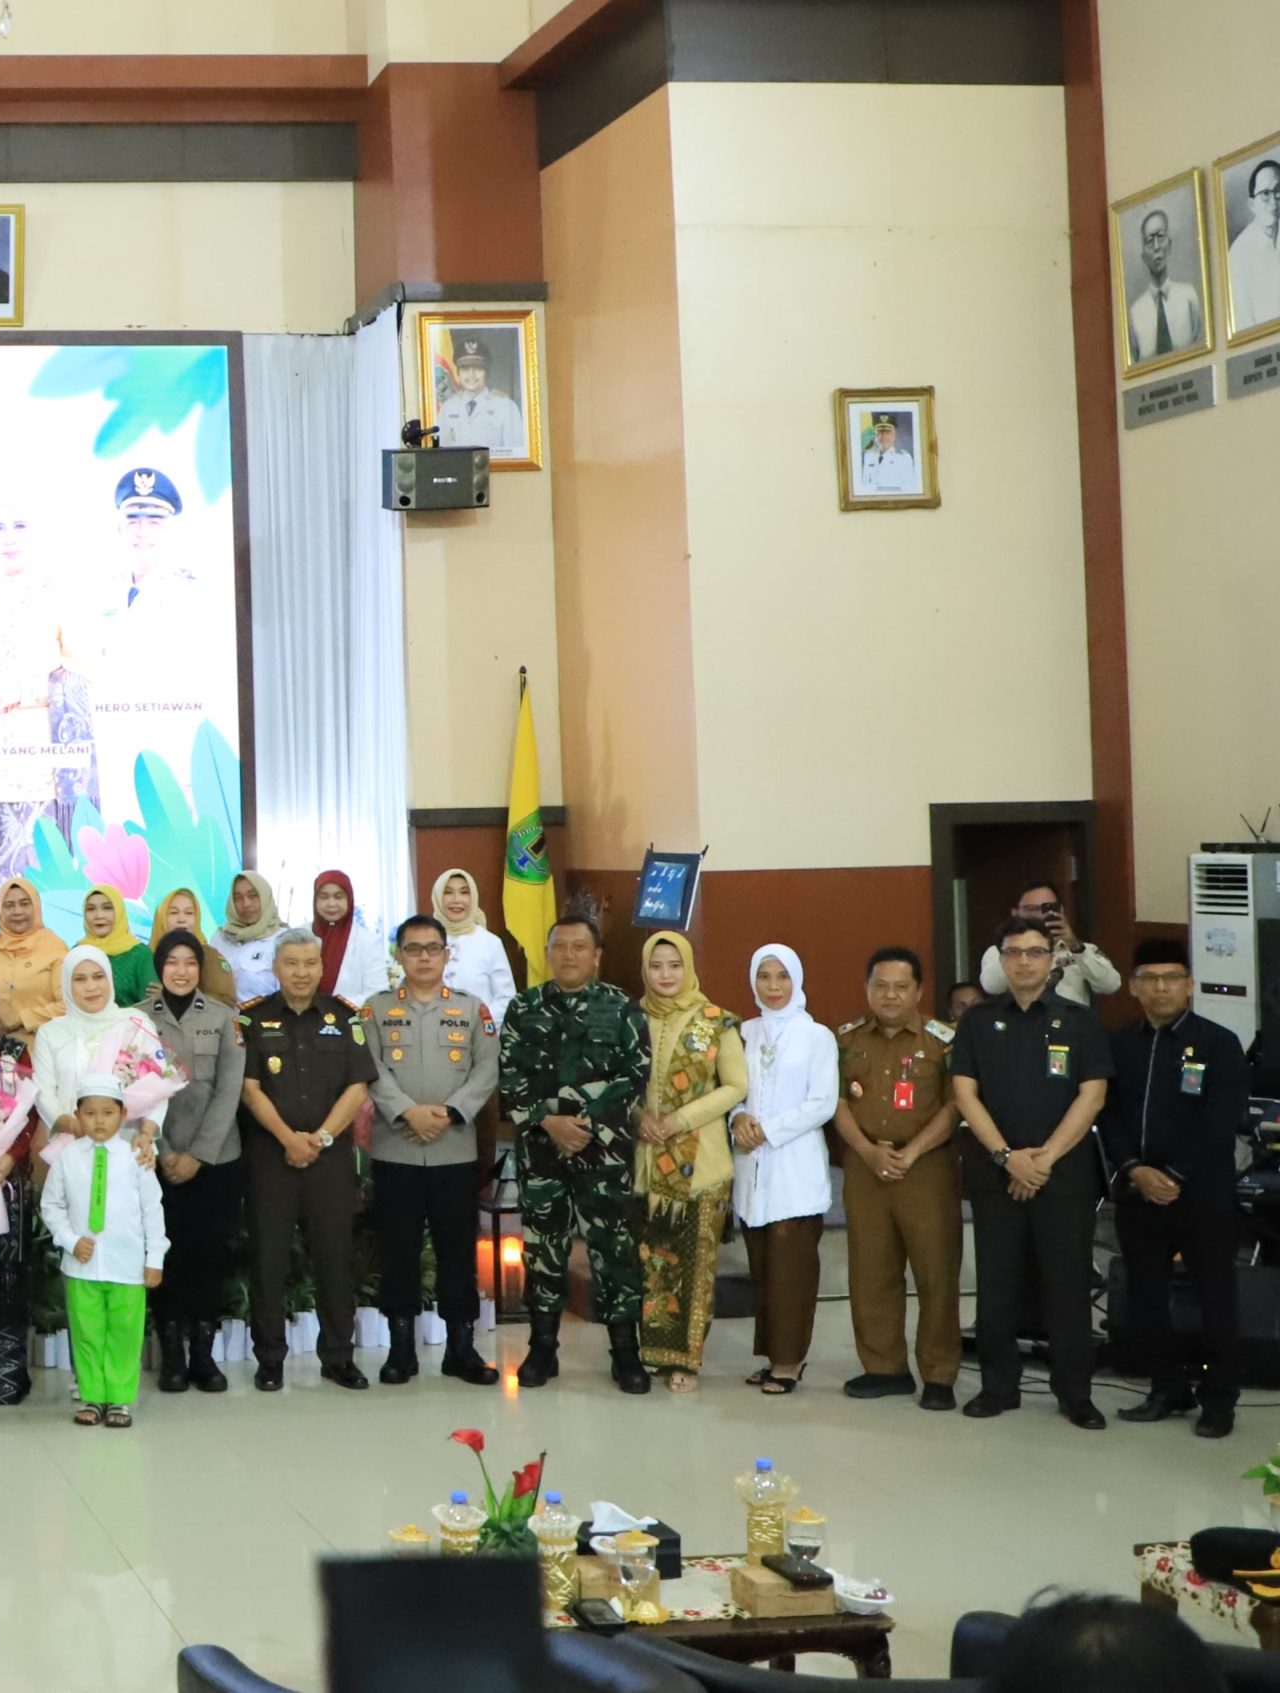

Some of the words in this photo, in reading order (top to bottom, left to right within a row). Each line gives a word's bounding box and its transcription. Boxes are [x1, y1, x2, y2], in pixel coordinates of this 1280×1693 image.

[95, 703, 131, 713] HERO
[134, 702, 203, 712] SETIAWAN
[40, 745, 90, 755] MELANI
[440, 1020, 470, 1028] POLRI
